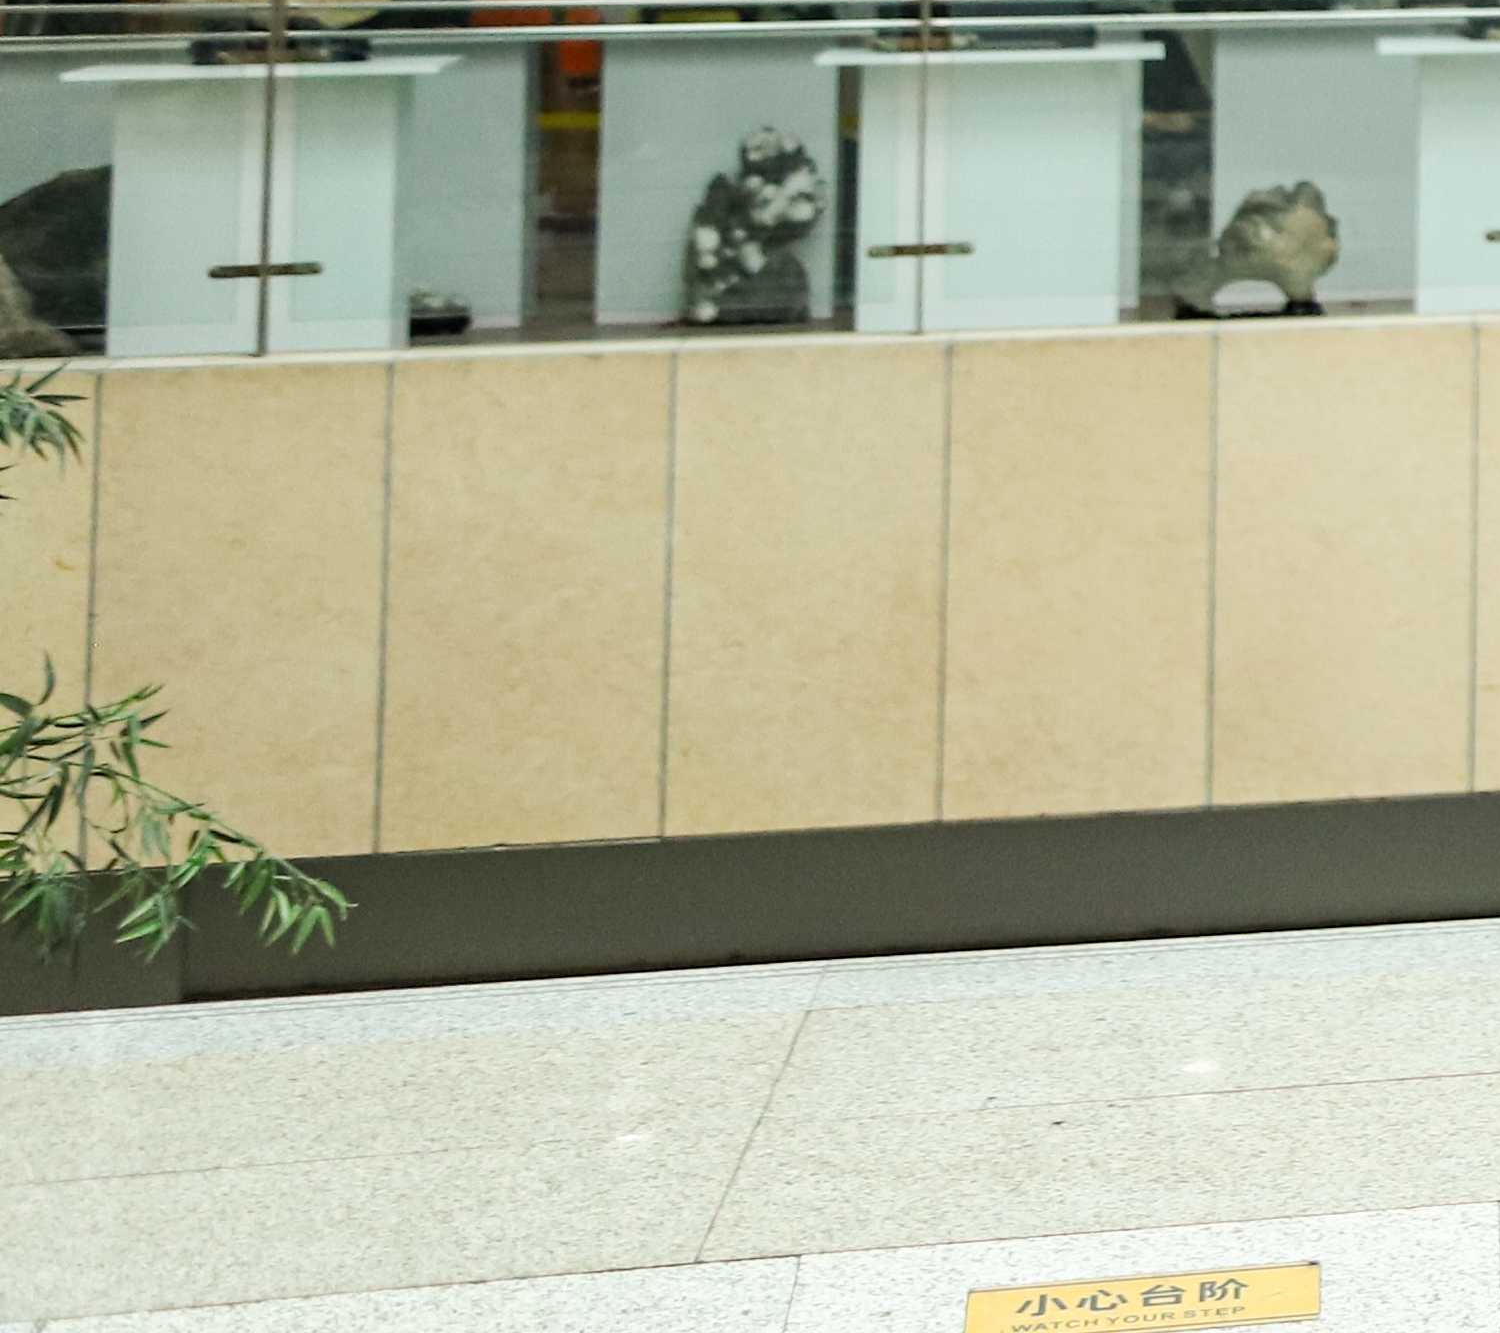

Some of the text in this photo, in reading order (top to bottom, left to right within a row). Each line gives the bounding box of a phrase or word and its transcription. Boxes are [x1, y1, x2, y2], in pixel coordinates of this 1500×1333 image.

[1015, 1277, 1249, 1317] 小心台阶
[1011, 1304, 1247, 1333] WATCH YOUR STEP
